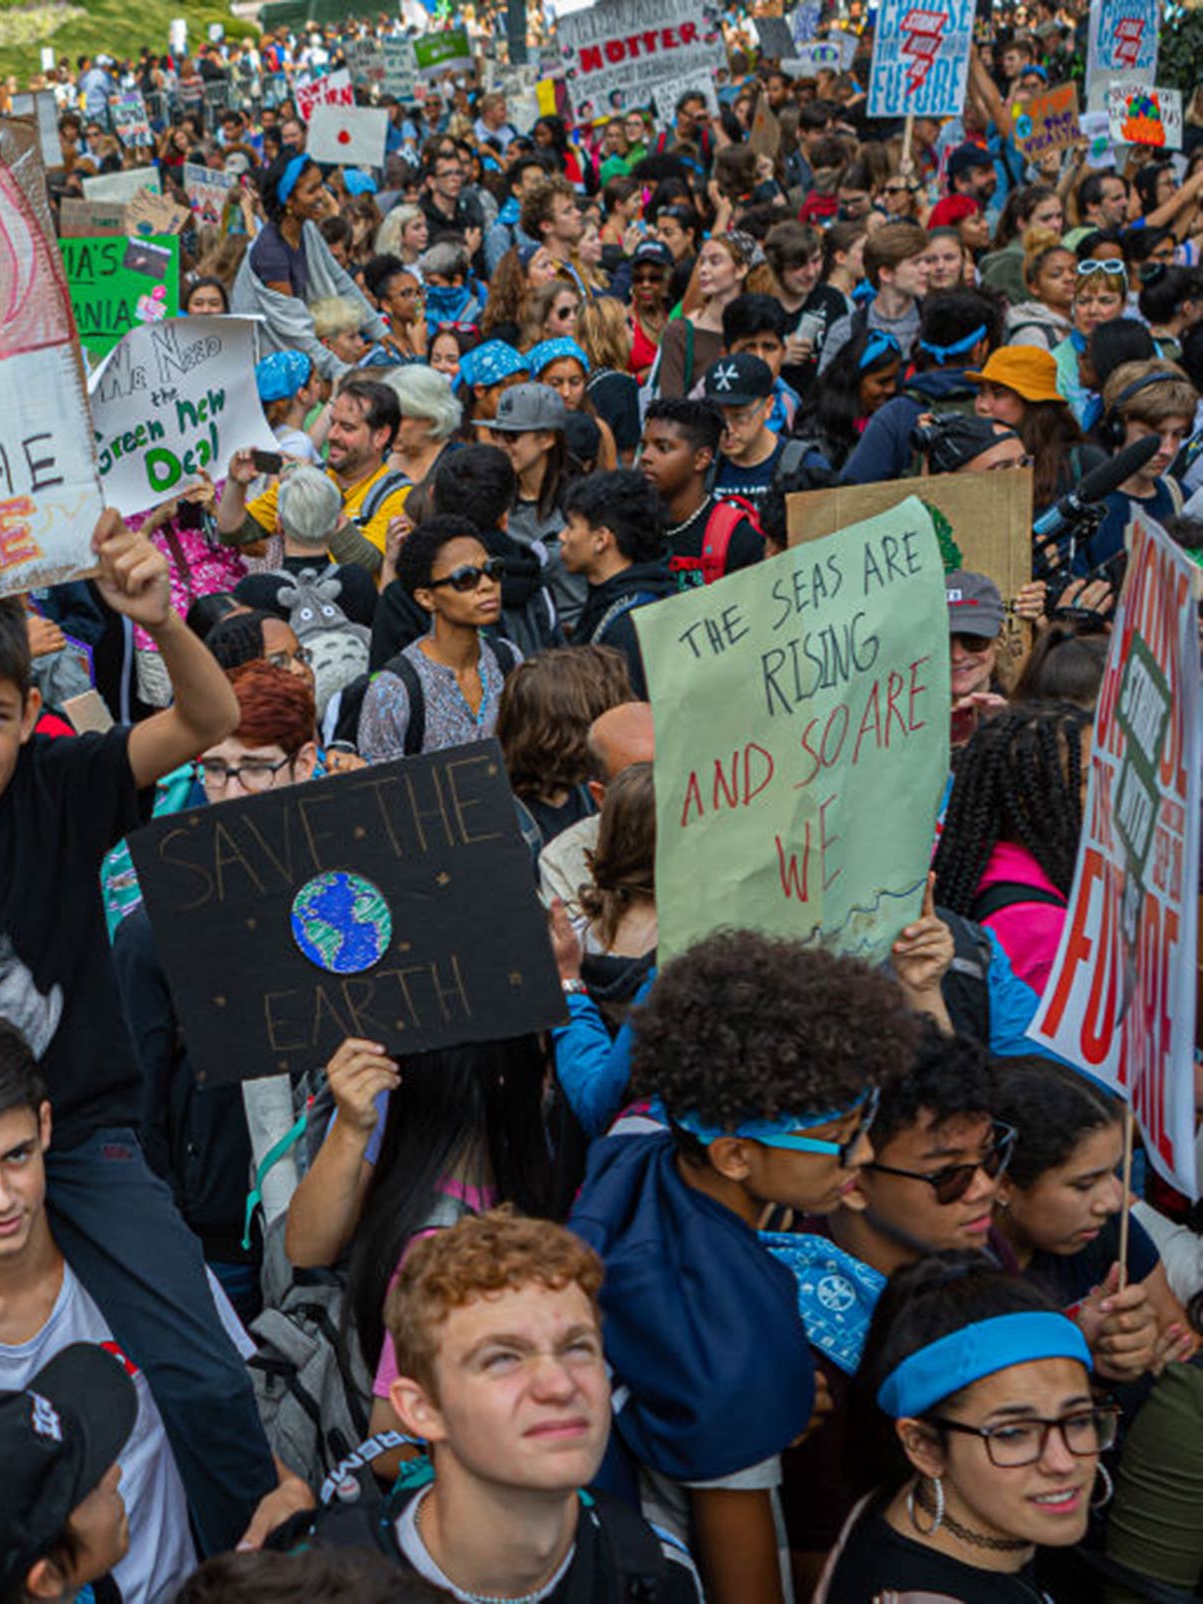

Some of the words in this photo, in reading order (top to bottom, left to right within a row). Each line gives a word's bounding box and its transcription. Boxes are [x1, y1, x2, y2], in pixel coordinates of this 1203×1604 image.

[678, 605, 749, 660] THE
[771, 554, 844, 631] SEAS
[862, 531, 924, 596] ARE
[761, 612, 880, 717] RISING
[681, 742, 775, 828] AND
[794, 703, 851, 789] SO
[852, 657, 931, 766] ARE
[160, 795, 338, 911] SAVE
[351, 755, 503, 857] THE
[775, 794, 843, 902] WE
[264, 954, 472, 1051] EARTH
